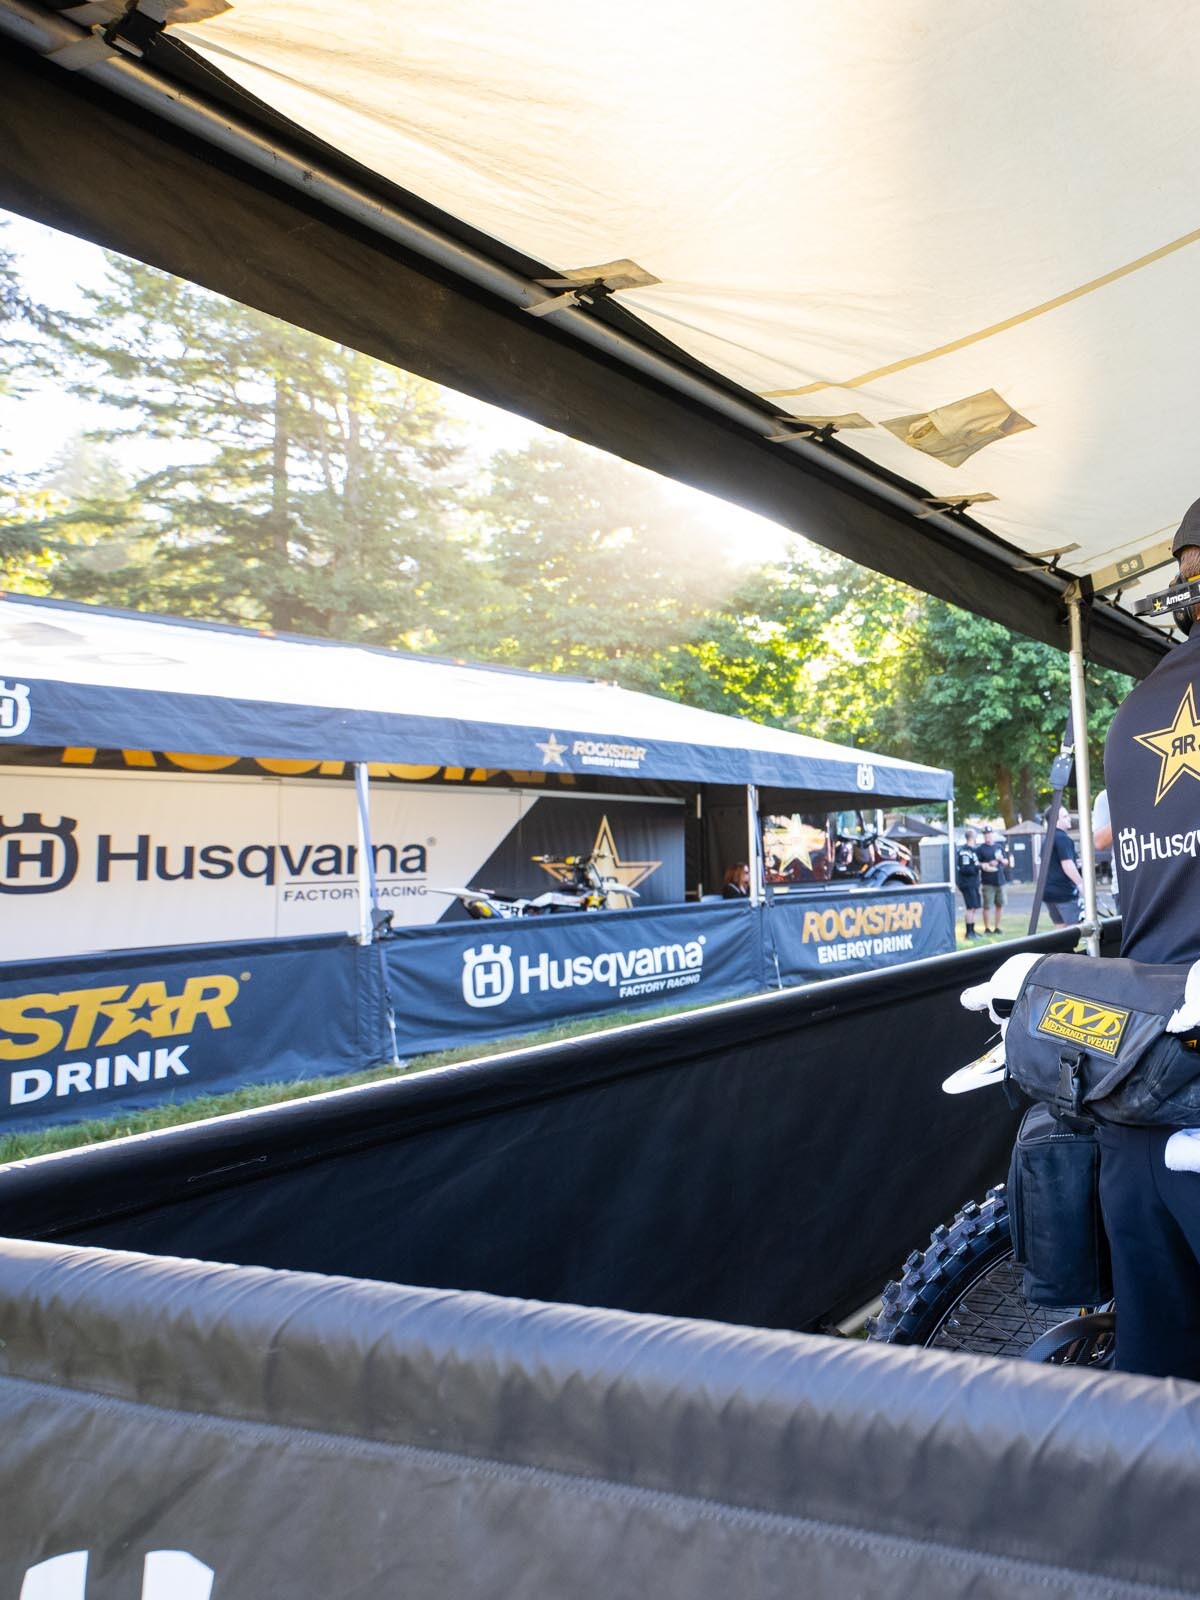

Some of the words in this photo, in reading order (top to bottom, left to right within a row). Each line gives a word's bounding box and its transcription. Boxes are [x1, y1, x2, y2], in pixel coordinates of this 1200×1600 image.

[572, 740, 648, 761] ROCKSTAR
[802, 901, 923, 944] ROCKSTAR
[519, 940, 703, 994] Husqvarna
[817, 939, 873, 964] ENERGY
[873, 934, 913, 955] DRINK
[619, 980, 665, 998] FACTORY
[666, 973, 701, 991] RACING
[1041, 1016, 1087, 1041] MECHANIX
[1086, 1035, 1115, 1052] WEAR
[10, 1045, 191, 1105] DRINK
